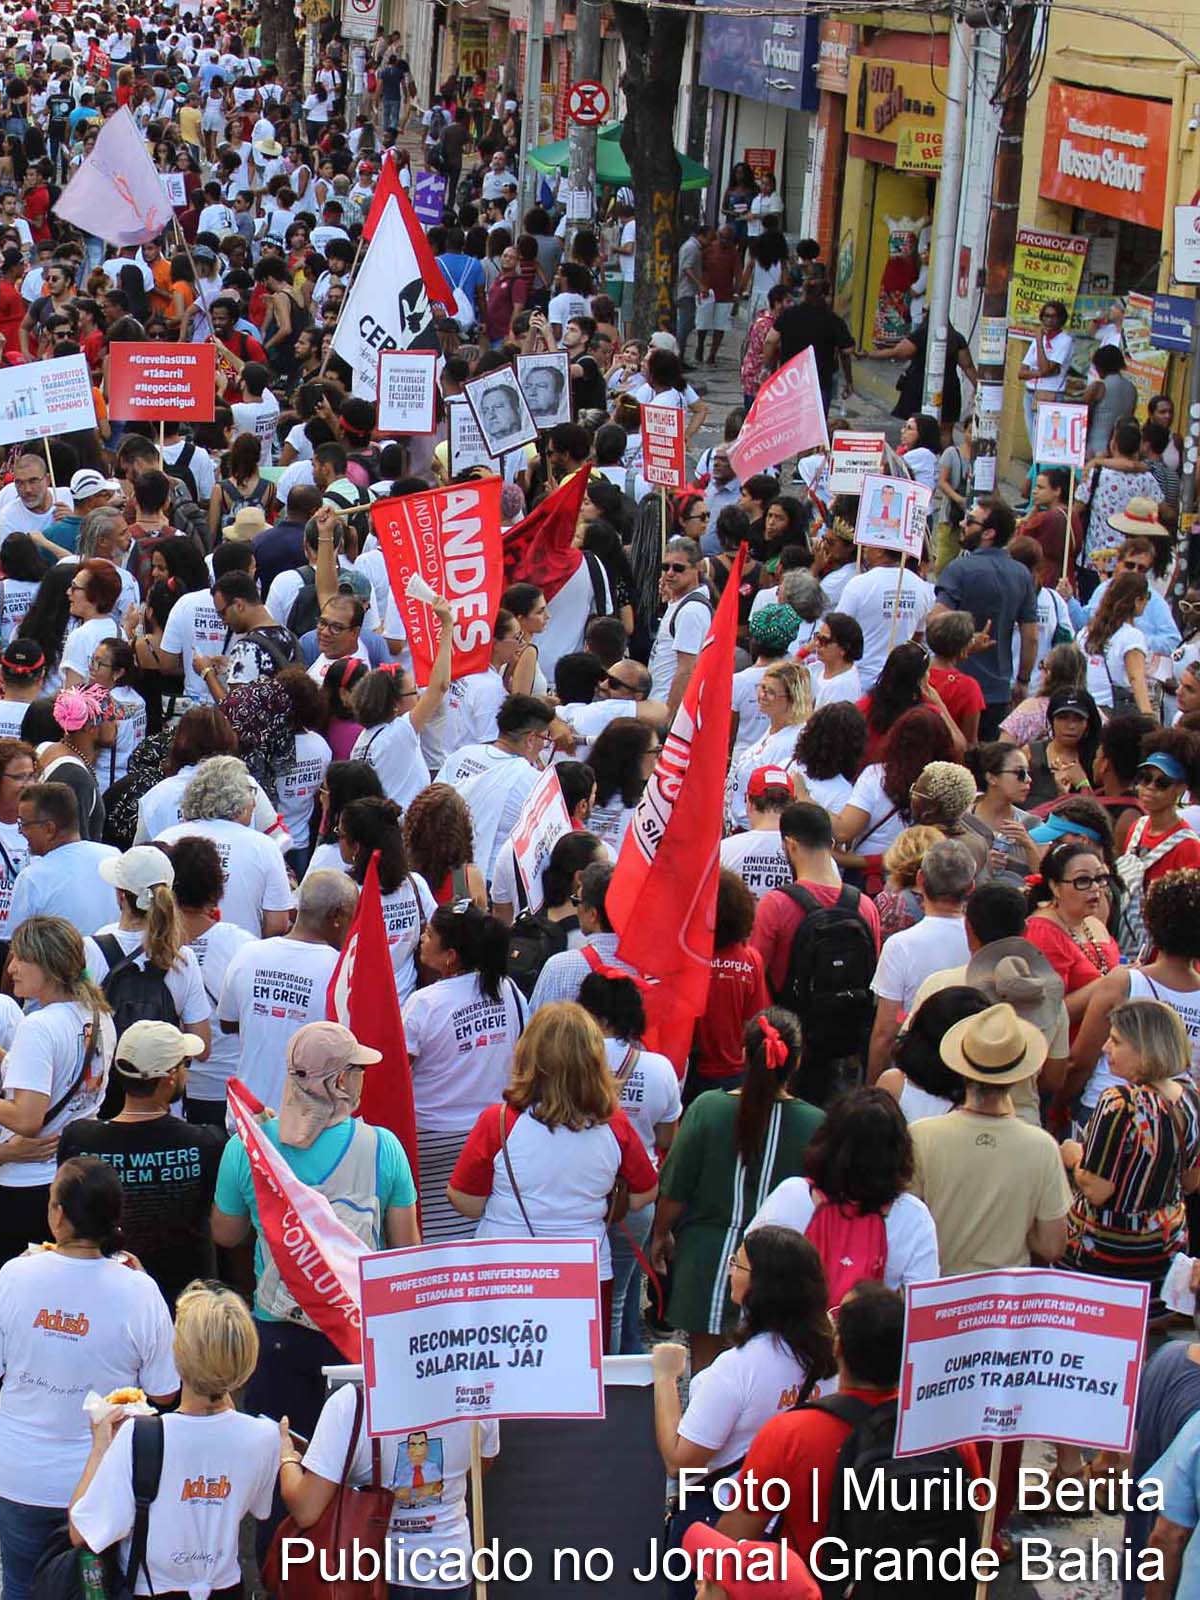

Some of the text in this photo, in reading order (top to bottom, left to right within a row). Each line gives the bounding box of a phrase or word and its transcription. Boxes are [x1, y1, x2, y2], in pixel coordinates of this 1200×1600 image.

[921, 146, 943, 160] BE
[902, 160, 942, 170] Malha
[1057, 139, 1146, 192] Nosso Sabor
[1019, 232, 1084, 252] PROMOÇÃO
[129, 355, 197, 365] #GreveDasUEBA
[134, 382, 191, 395] #NegociaRui
[441, 488, 490, 653] ANDES
[389, 521, 423, 645] CSP COLUTAS
[883, 601, 892, 609] EM
[194, 619, 207, 628] EM
[285, 771, 321, 786] EM GREVE
[743, 874, 792, 887] EM GRE
[389, 915, 416, 931] GREV
[710, 957, 754, 973] ut.org.br
[255, 968, 313, 987] UNIVERSIDADES
[253, 985, 310, 1008] EM GREVE
[455, 1014, 507, 1041] EM GREVE
[129, 1147, 199, 1168] WATERS
[117, 1164, 200, 1183] HEM 2018
[281, 1203, 362, 1328] CONLUTAS
[389, 1268, 560, 1292] PROFESSORES DAS UNIVERSIDADES
[415, 1285, 535, 1304] ESTADUAIS REIVINDICAM
[935, 1299, 1105, 1320] PROFESSORES DAS UNIVERSIDADES
[32, 1308, 90, 1337] Adusb
[958, 1314, 1076, 1330] ESTADUAIS REIVINDICAM
[409, 1319, 548, 1356] RECOMPOSIÇÃO
[415, 1351, 501, 1380] SALARIAL
[944, 1350, 1084, 1374] CUMPRIMENTO DE
[916, 1371, 1118, 1402] DIREITOS TRABALHISTAS!
[181, 1474, 232, 1502] Adusb
